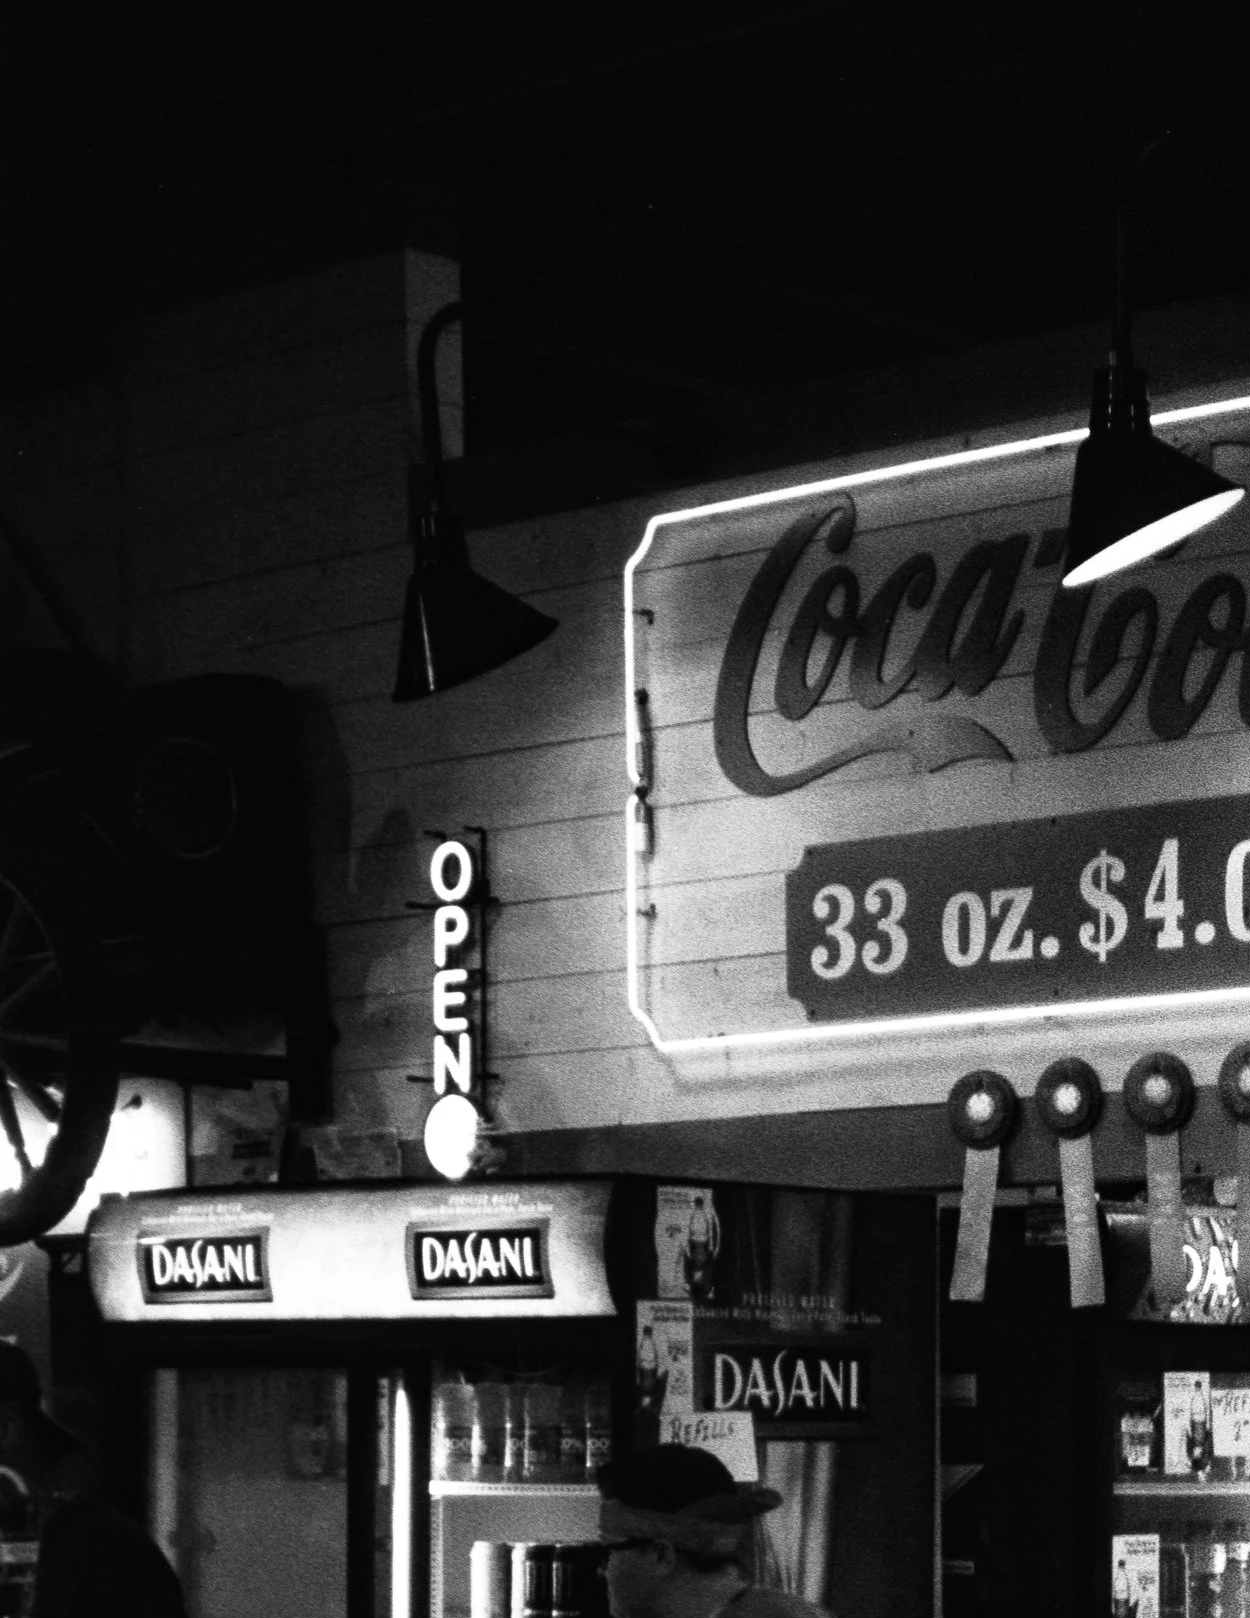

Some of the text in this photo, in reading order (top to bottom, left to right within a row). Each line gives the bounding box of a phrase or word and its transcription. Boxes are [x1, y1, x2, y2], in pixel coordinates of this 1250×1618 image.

[810, 878, 908, 979] 33
[431, 841, 472, 1094] OPEN
[151, 1239, 256, 1288] DASANI
[421, 1231, 534, 1284] DASANI
[714, 1350, 859, 1417] DASANI
